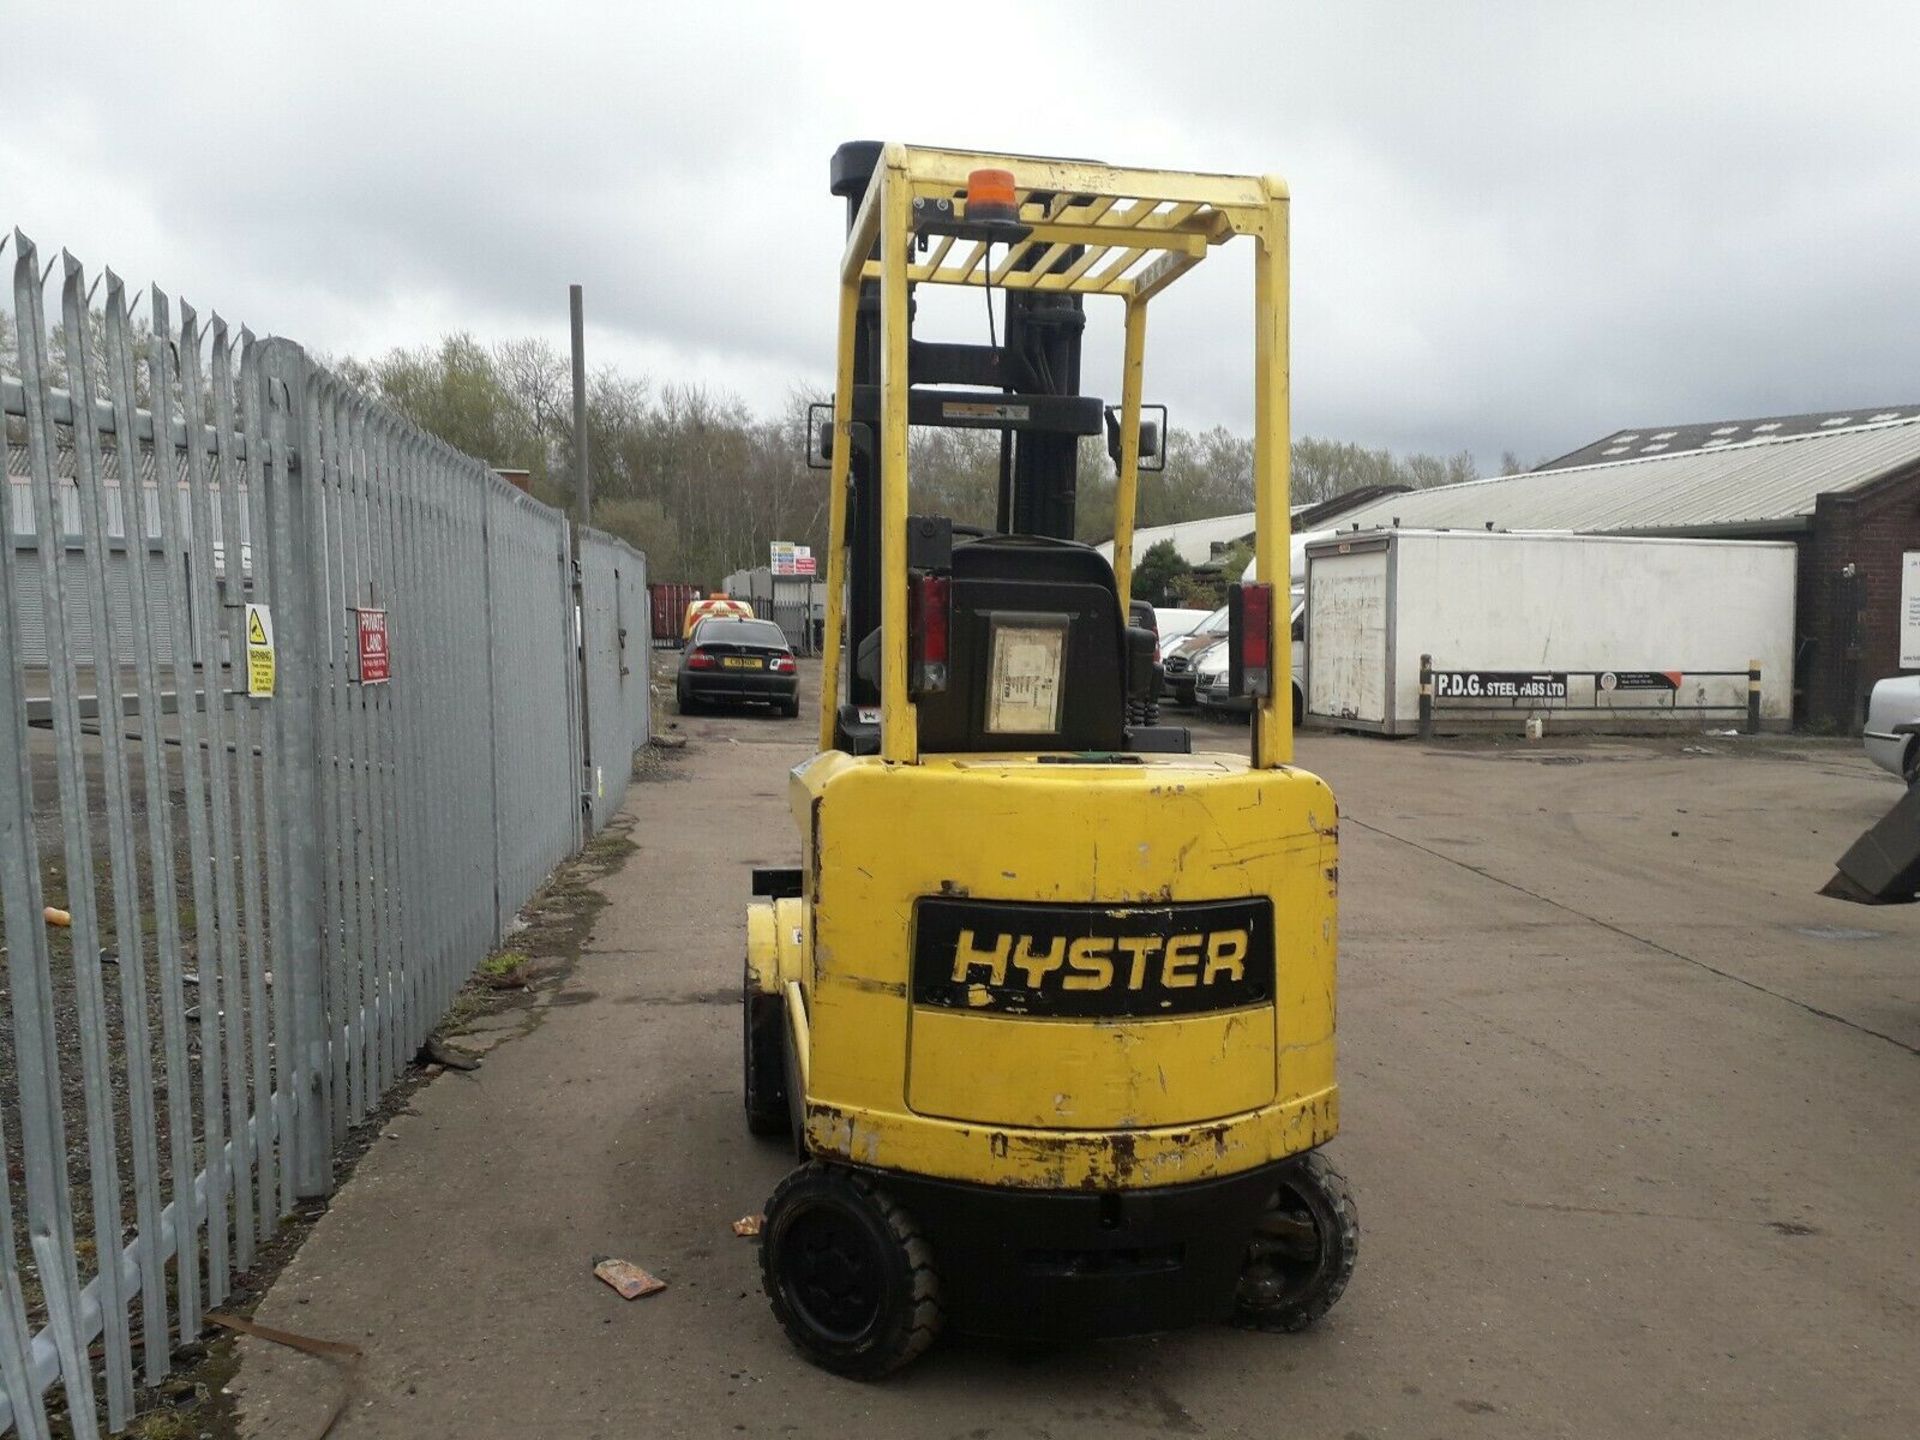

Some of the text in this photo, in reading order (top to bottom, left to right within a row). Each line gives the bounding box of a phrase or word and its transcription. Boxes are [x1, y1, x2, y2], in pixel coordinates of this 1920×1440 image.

[365, 633, 381, 653] LAND
[1438, 674, 1484, 696] P.D.G.
[1487, 682, 1518, 696] STEEL
[1547, 682, 1565, 696] LTD
[952, 929, 1249, 991] HYSTER
